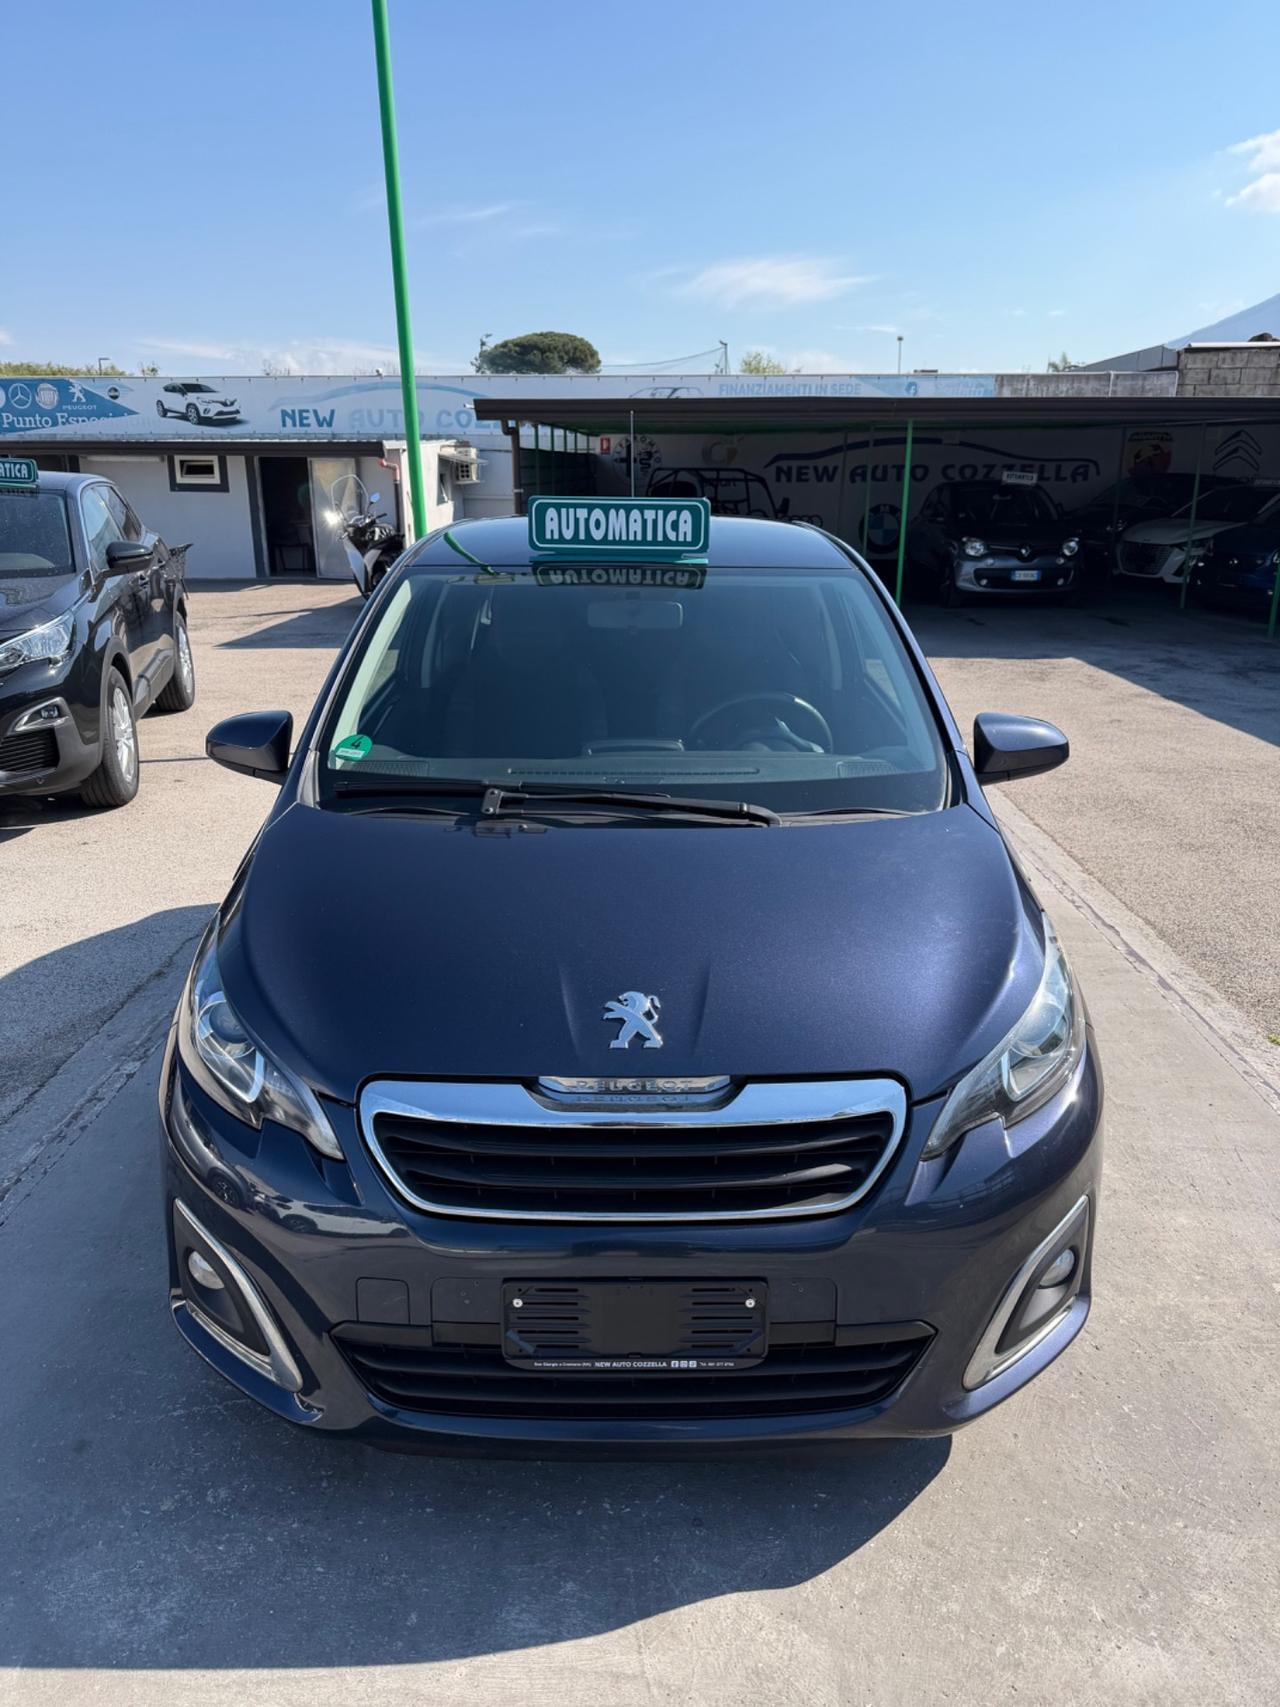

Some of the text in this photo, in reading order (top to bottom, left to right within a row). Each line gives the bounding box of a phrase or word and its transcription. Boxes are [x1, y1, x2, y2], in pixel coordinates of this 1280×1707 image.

[719, 383, 862, 396] FINANZIAMENTI IN SEDE
[1, 413, 52, 428] Punto
[281, 408, 335, 428] NEW
[775, 465, 839, 483] NEW
[849, 464, 929, 484] AUTO
[545, 507, 692, 542] AUTOMATICA
